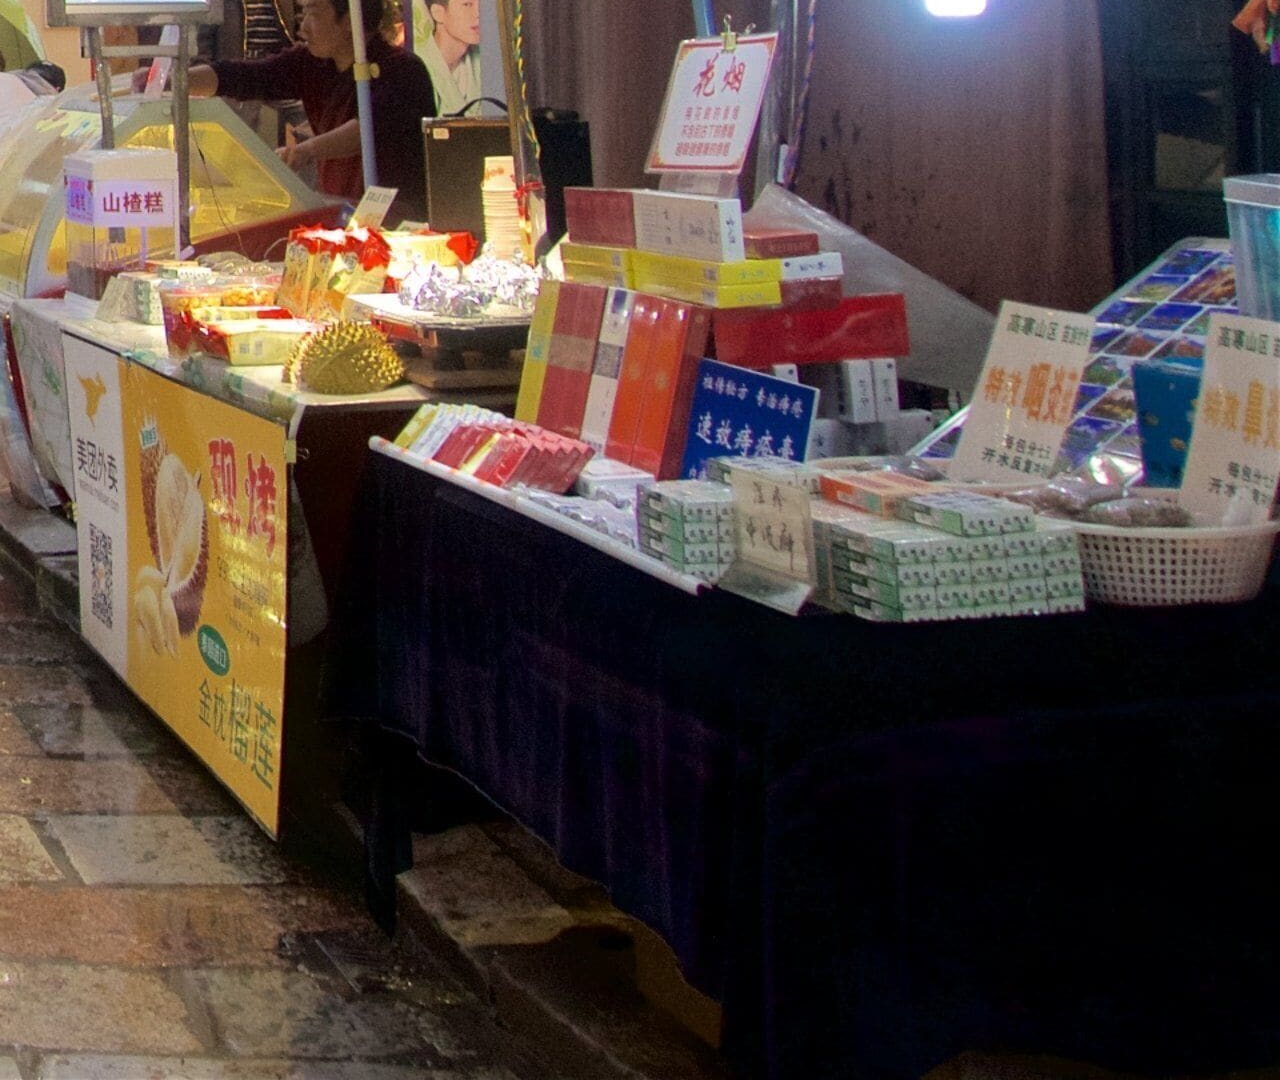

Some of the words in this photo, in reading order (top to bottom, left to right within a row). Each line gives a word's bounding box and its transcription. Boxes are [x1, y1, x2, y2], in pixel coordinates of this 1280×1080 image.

[693, 52, 745, 97] 花烟
[103, 191, 164, 214] 山楂糕
[77, 437, 118, 492] 美团外卖
[209, 437, 278, 560] 现烤
[198, 677, 276, 791] 金枕榴莲
